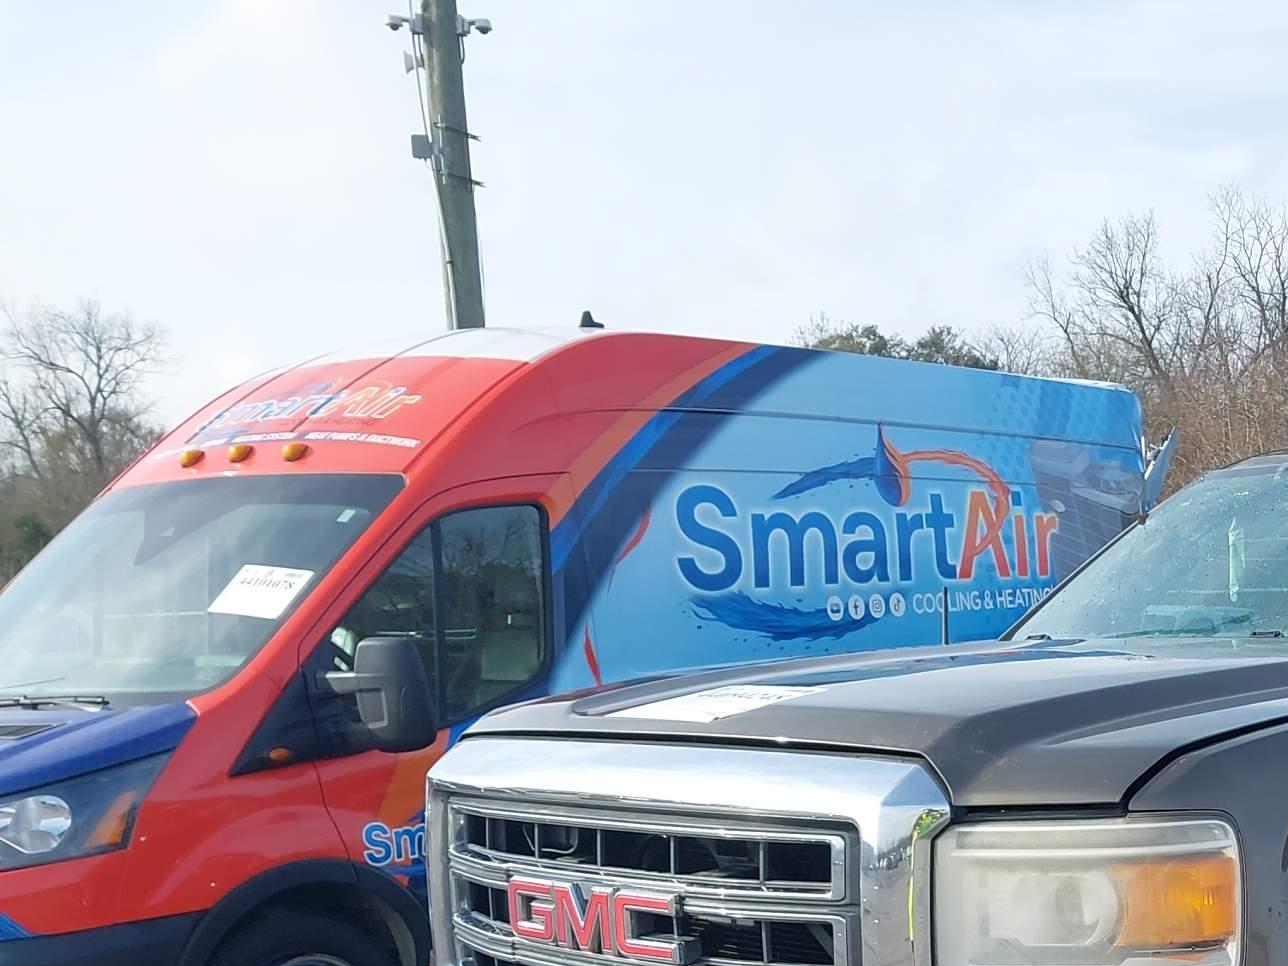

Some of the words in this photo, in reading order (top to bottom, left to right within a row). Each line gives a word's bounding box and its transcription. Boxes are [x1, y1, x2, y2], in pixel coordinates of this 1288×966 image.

[675, 484, 1058, 592] SmartAir
[912, 590, 980, 615] COOLING
[984, 589, 994, 610] &
[508, 876, 684, 966] GMC
